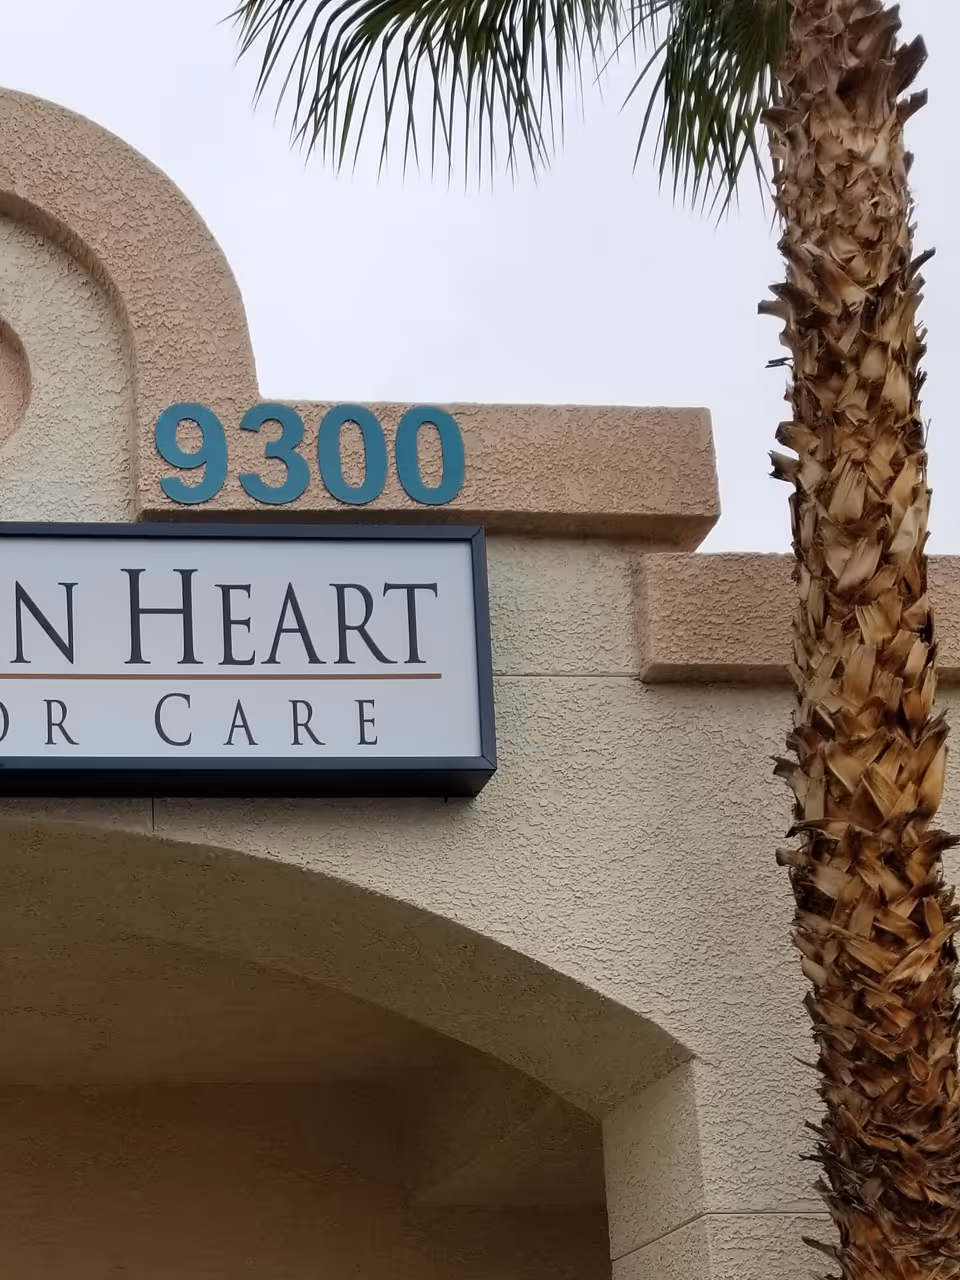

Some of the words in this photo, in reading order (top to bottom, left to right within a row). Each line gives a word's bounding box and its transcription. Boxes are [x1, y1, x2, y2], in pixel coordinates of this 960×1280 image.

[154, 403, 465, 506] 9300
[120, 567, 439, 667] HEART
[153, 692, 381, 747] CARE
